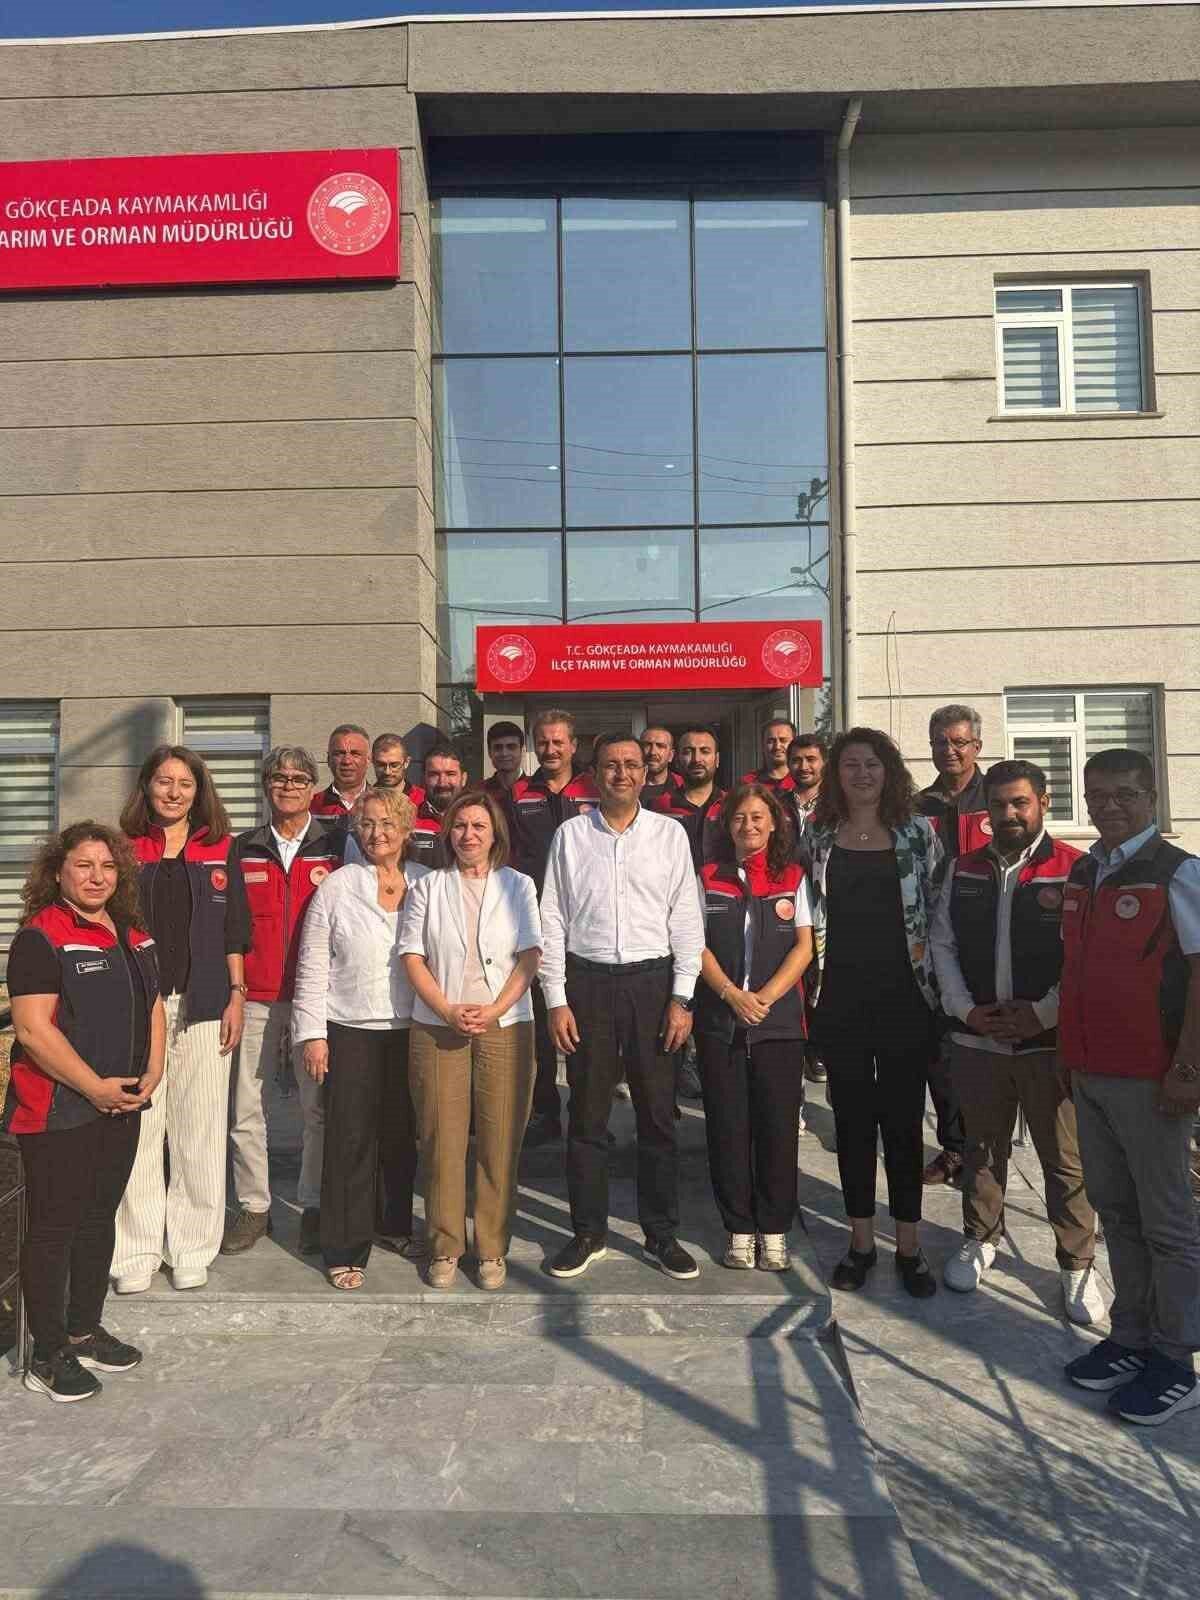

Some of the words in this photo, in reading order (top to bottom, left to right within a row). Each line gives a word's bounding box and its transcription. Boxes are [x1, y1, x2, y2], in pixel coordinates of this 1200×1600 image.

[5, 197, 112, 222] GÖKÇEADA
[118, 189, 268, 215] KAYMAKAMLIĞI
[0, 229, 47, 249] ARIM
[52, 228, 77, 247] VE
[81, 225, 156, 246] ORMAN
[162, 216, 293, 243] MÜDÜRLÜĞÜ
[586, 644, 646, 657] GÖKÇEADA
[649, 641, 733, 654] KAYMAKAMLIĞI
[576, 659, 610, 671] TARIM
[612, 659, 626, 670] VE
[629, 658, 671, 669] ORMAN
[673, 655, 746, 669] MÜDÜRLÜĞÜ
